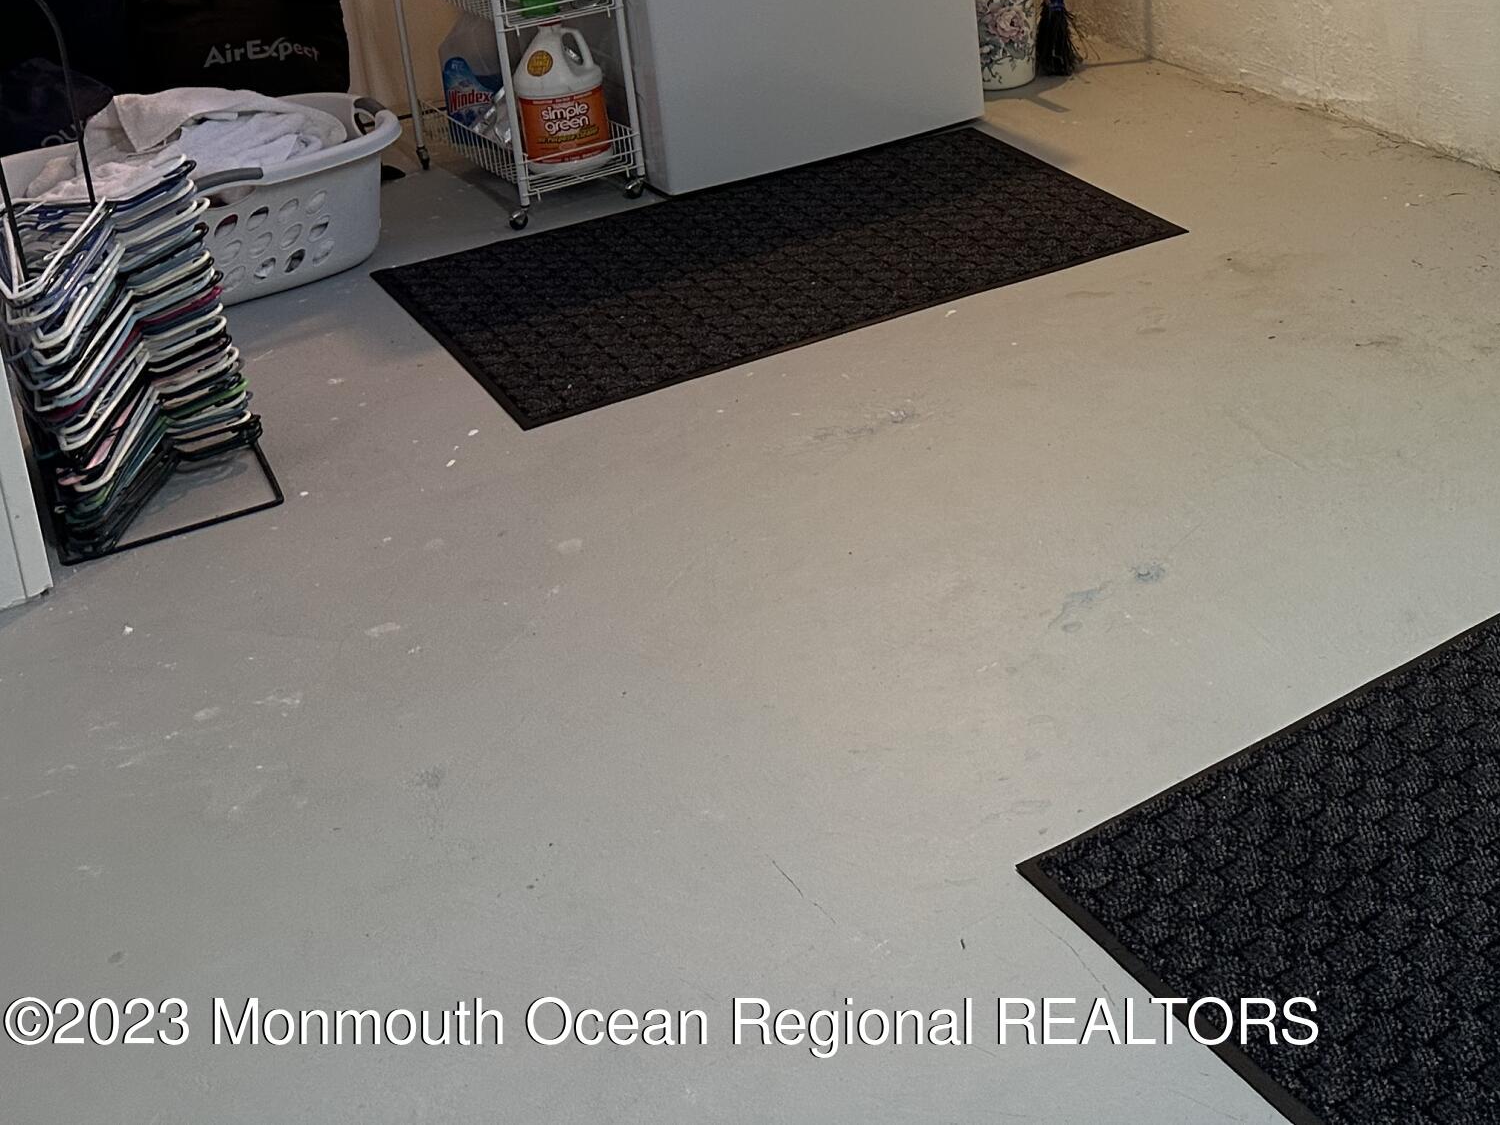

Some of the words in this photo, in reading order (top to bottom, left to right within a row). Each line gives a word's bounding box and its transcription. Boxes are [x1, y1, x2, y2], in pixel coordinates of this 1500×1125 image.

[203, 36, 320, 68] AirExpect
[448, 89, 493, 115] Windex
[541, 100, 589, 121] simple
[544, 116, 589, 136] green
